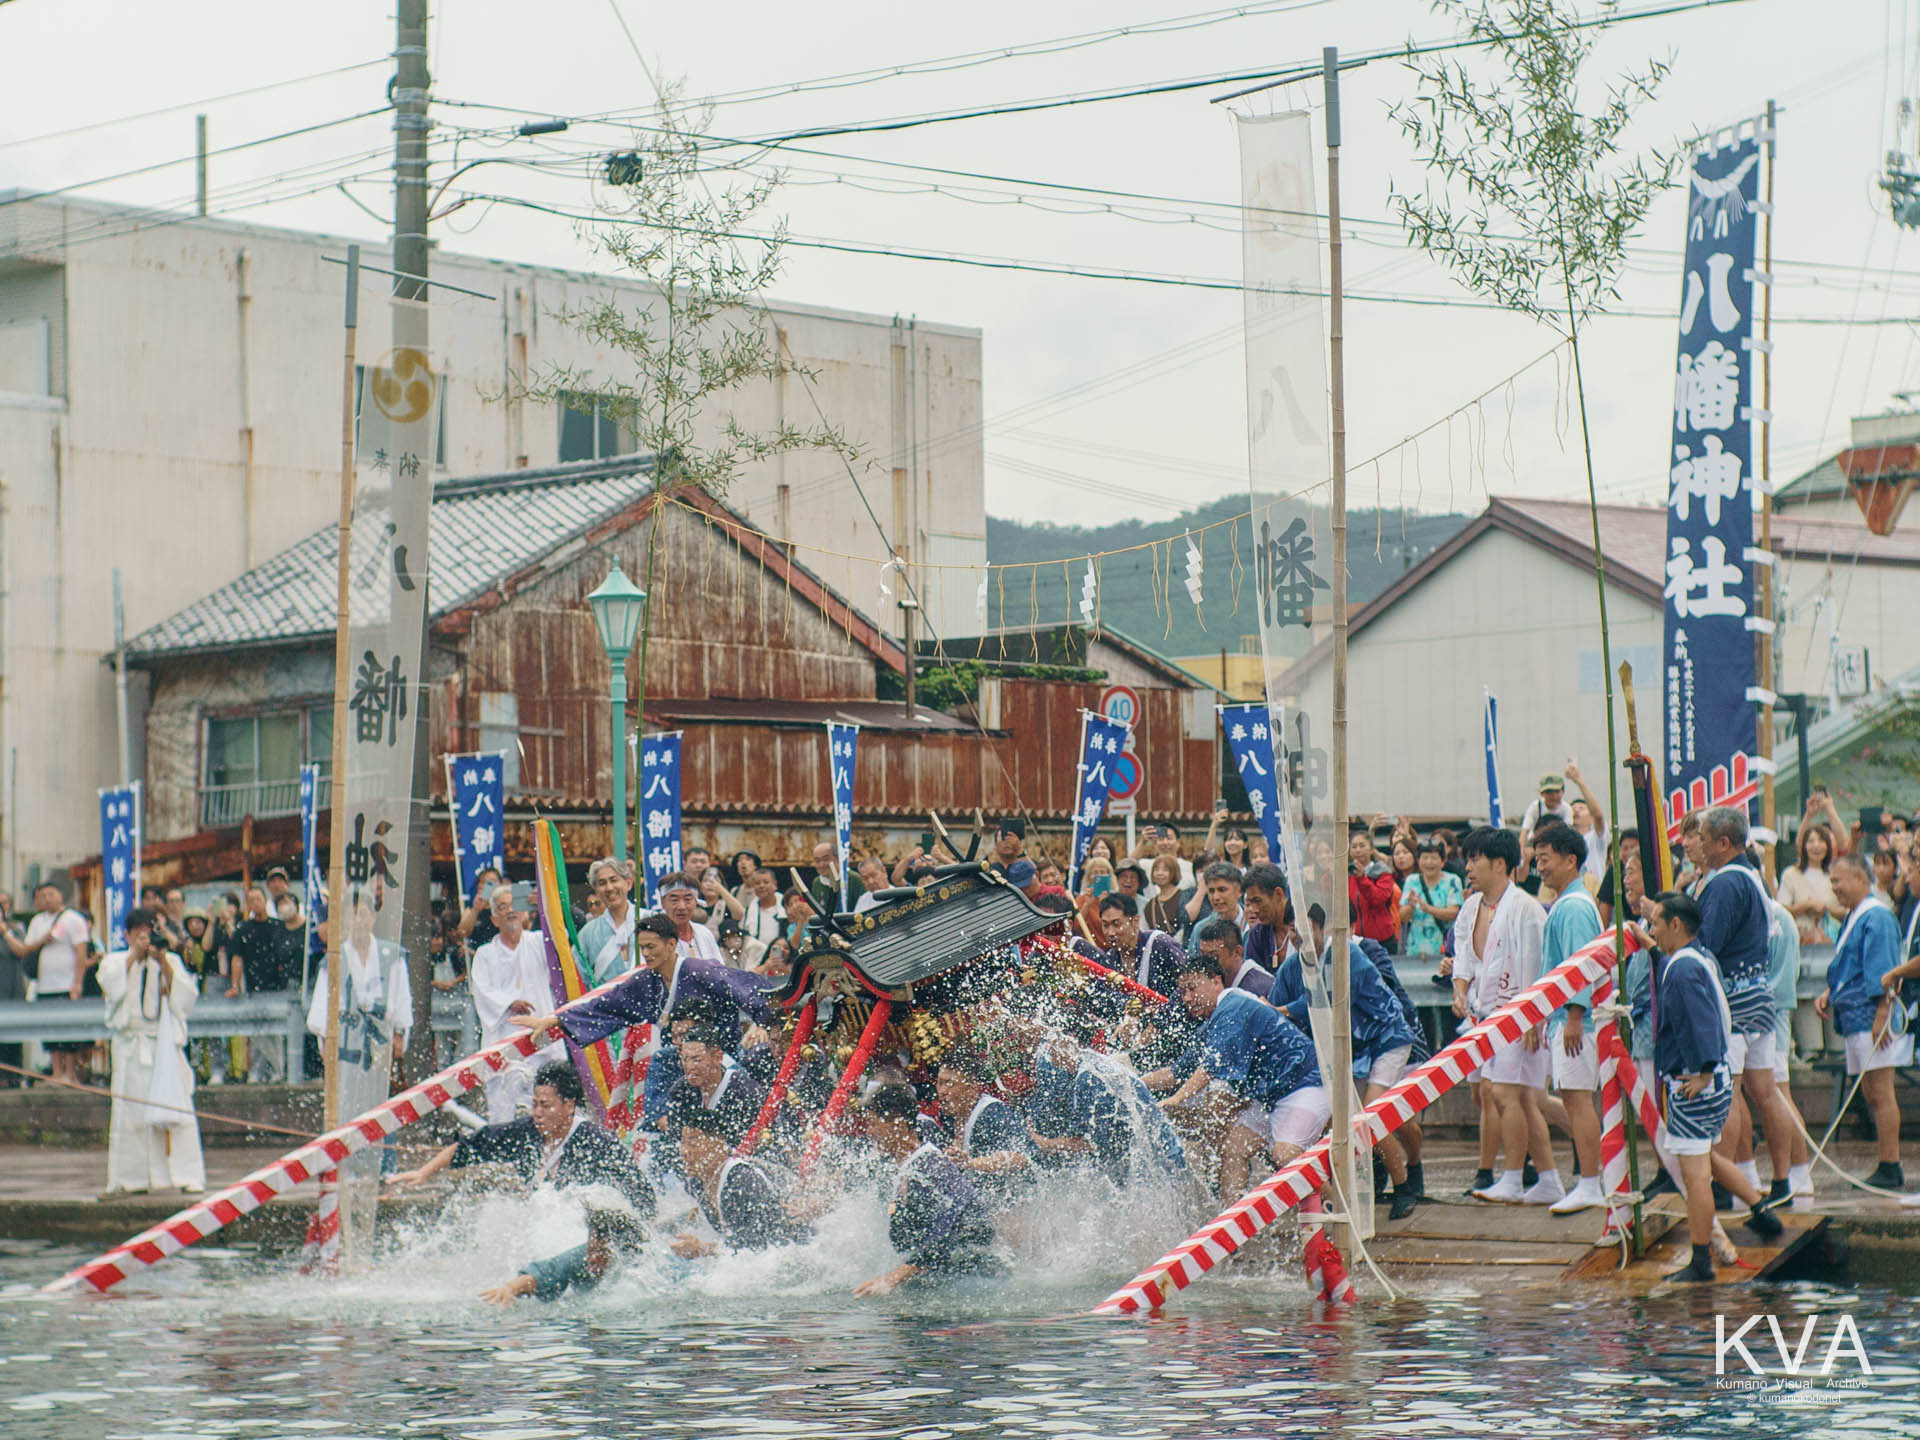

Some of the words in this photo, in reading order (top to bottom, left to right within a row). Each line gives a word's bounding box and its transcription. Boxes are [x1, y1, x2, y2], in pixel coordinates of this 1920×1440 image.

[1664, 252, 1747, 618] 八幡神社
[1109, 698, 1132, 721] 40
[1231, 722, 1268, 742] 奉納
